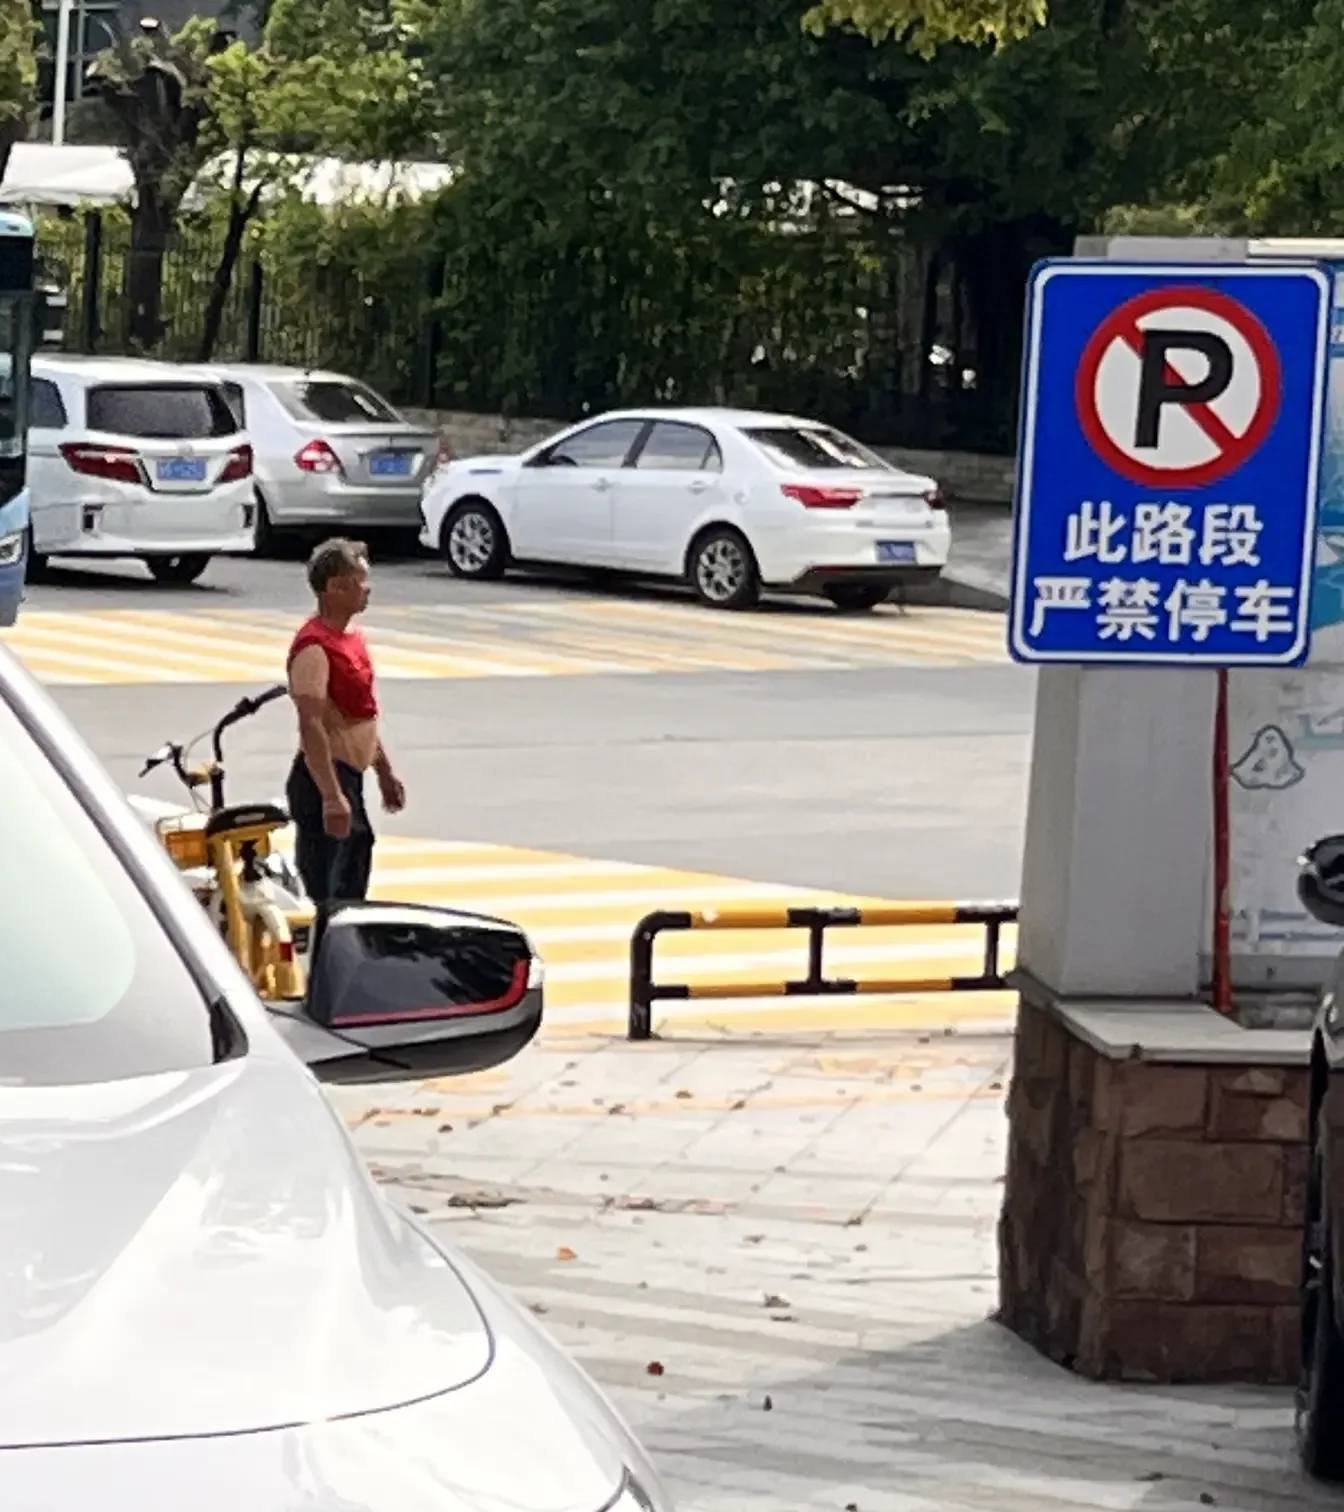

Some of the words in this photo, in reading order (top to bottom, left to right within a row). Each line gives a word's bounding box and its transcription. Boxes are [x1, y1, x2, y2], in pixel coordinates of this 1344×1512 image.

[1063, 502, 1263, 567] 此路段
[1028, 577, 1294, 642] 严禁停车
